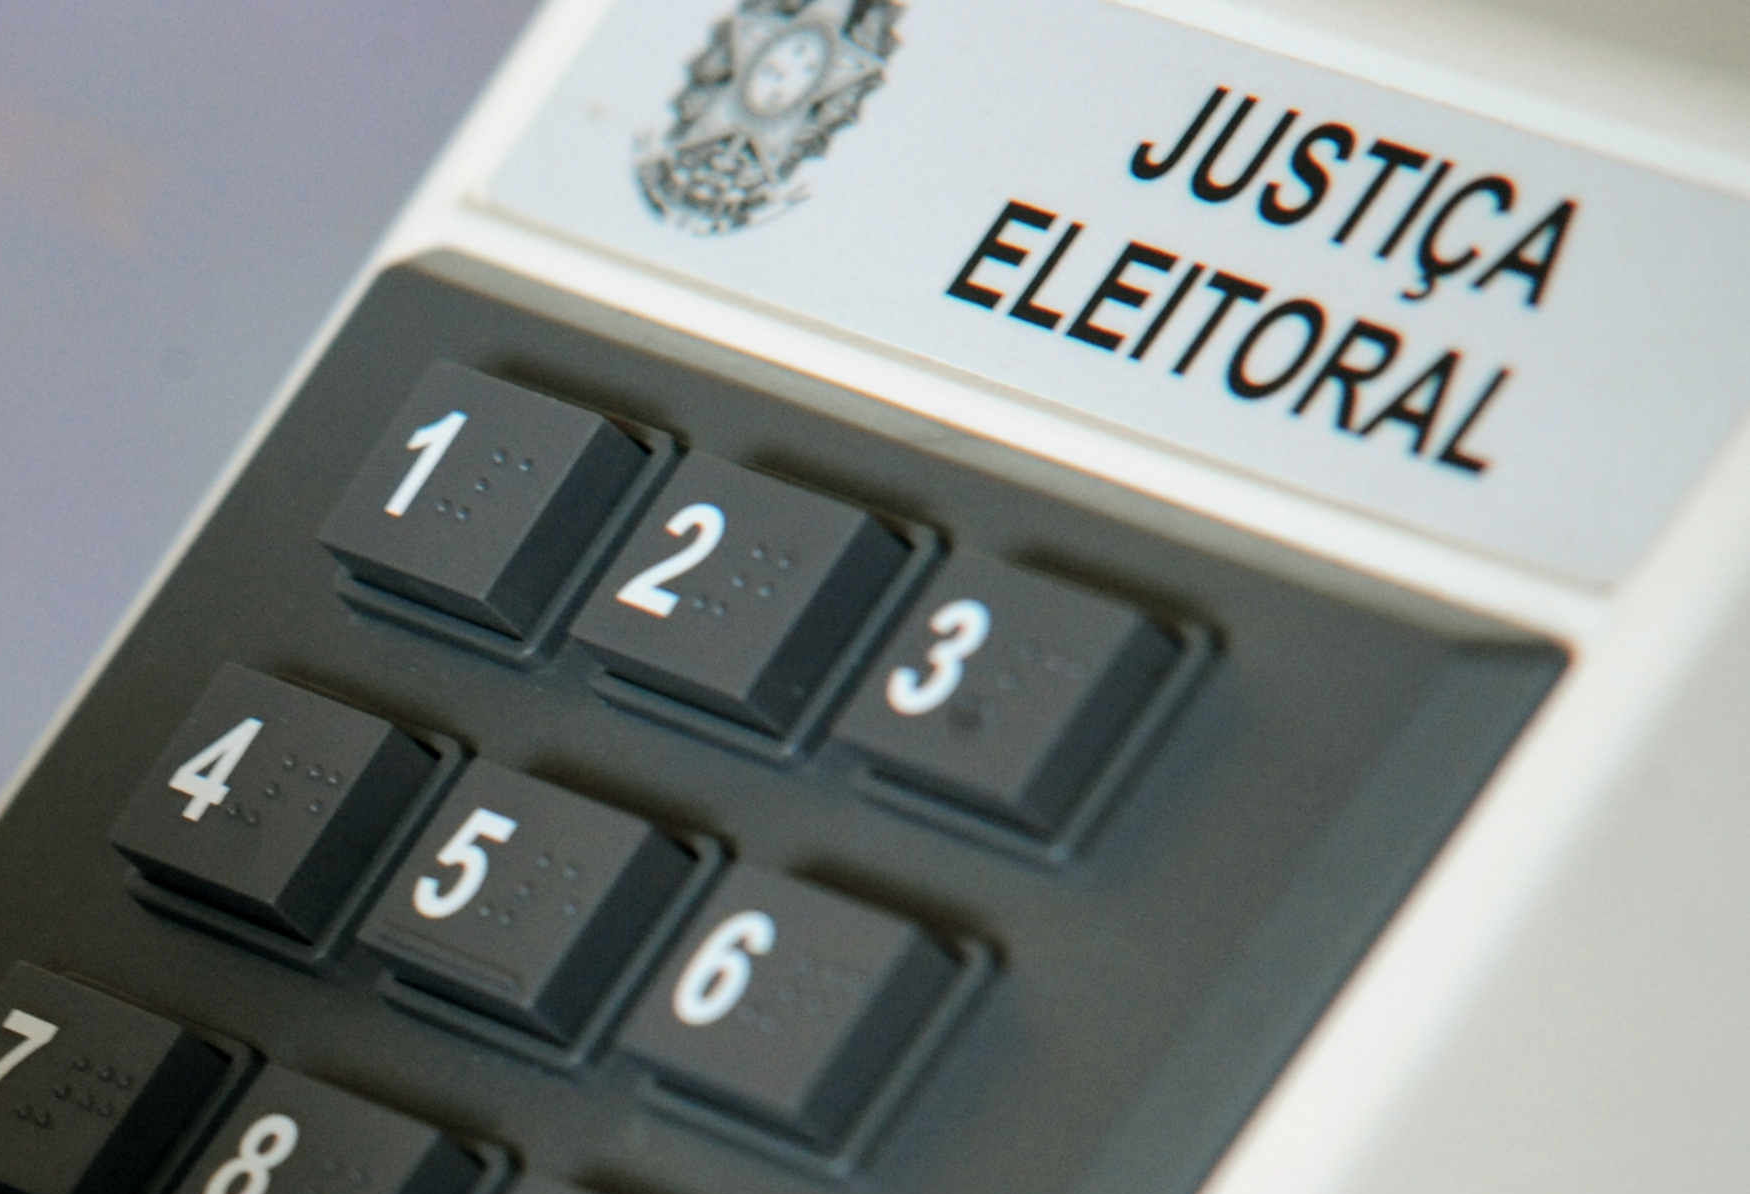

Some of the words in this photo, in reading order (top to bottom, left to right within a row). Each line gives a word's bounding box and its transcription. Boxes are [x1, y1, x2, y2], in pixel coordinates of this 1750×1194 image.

[1130, 86, 1578, 306] JUSTIÇA
[944, 200, 1509, 475] ELEITORAL
[385, 410, 467, 518] 1
[615, 502, 725, 617] 2
[887, 600, 990, 716] 3
[167, 717, 263, 822] 4
[412, 807, 517, 919] 5
[672, 910, 776, 1026] 6
